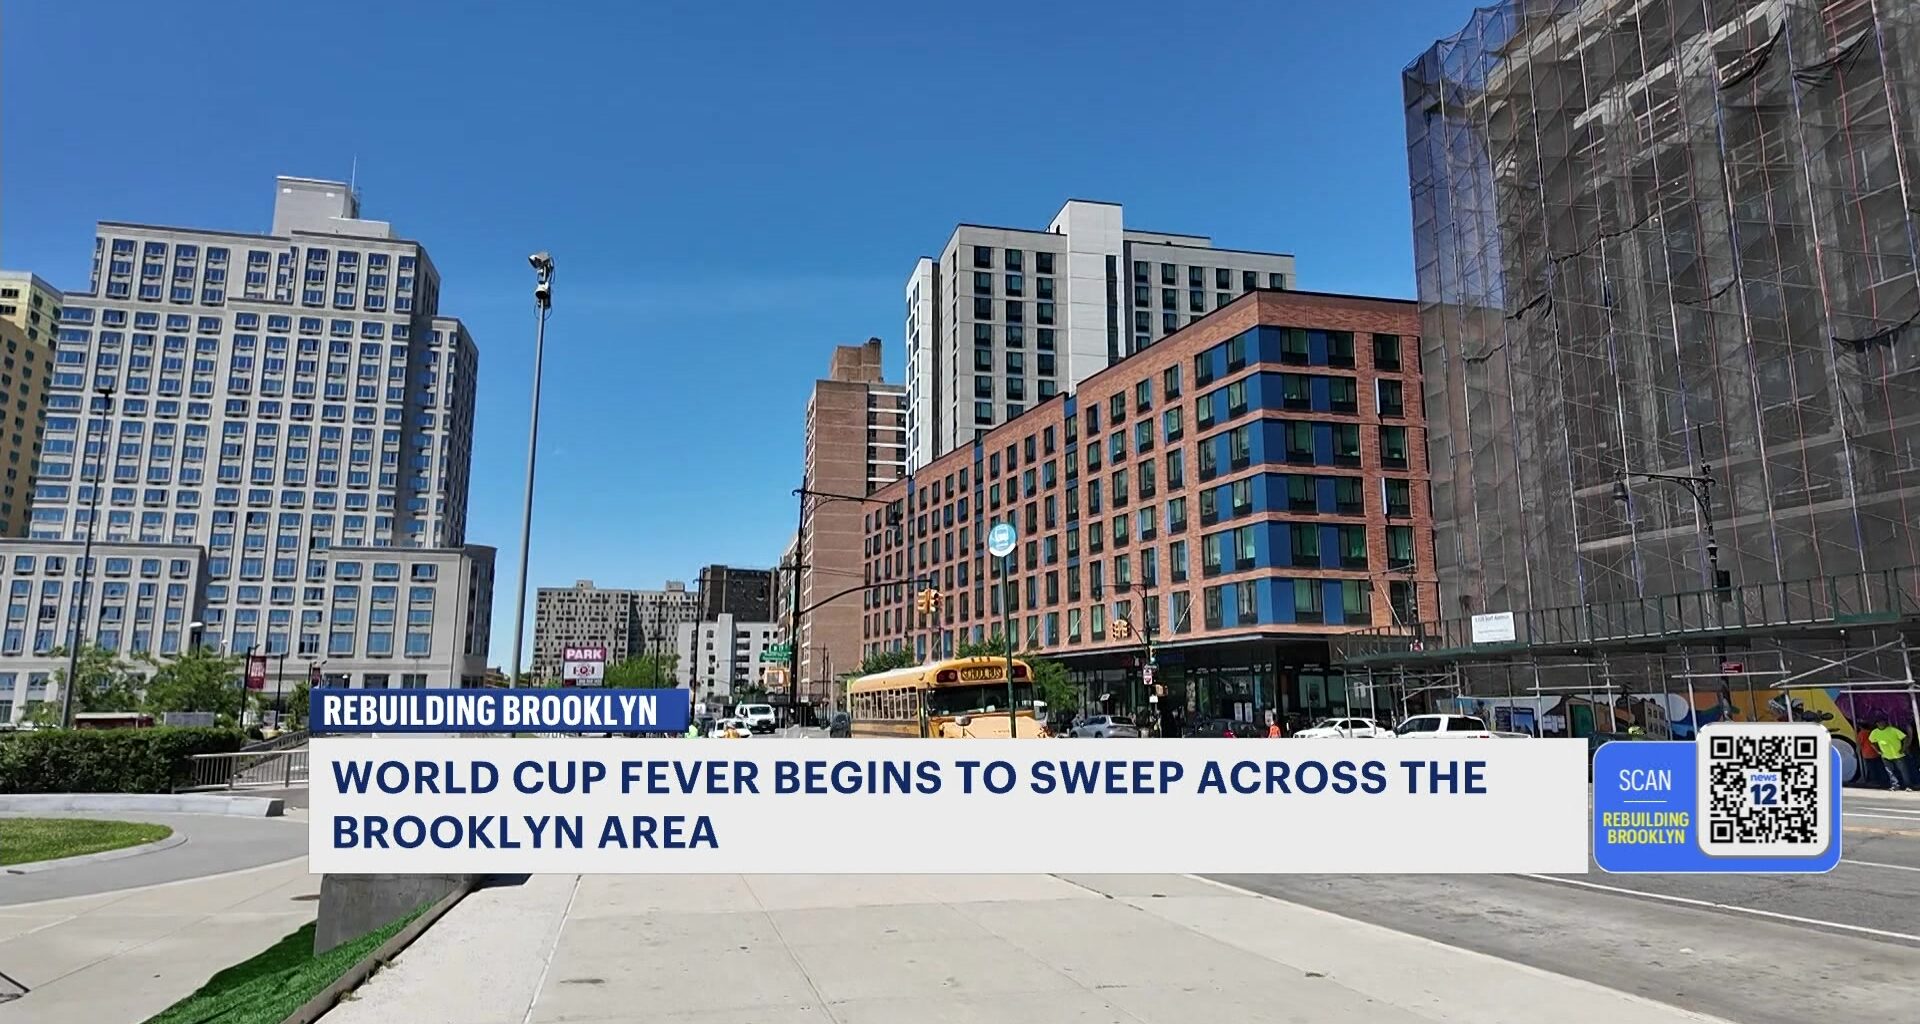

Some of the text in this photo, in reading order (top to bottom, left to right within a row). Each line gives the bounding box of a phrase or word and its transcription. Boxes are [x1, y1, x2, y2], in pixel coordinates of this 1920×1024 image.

[566, 649, 602, 659] PARK
[961, 668, 1002, 680] SCHOOL BUS
